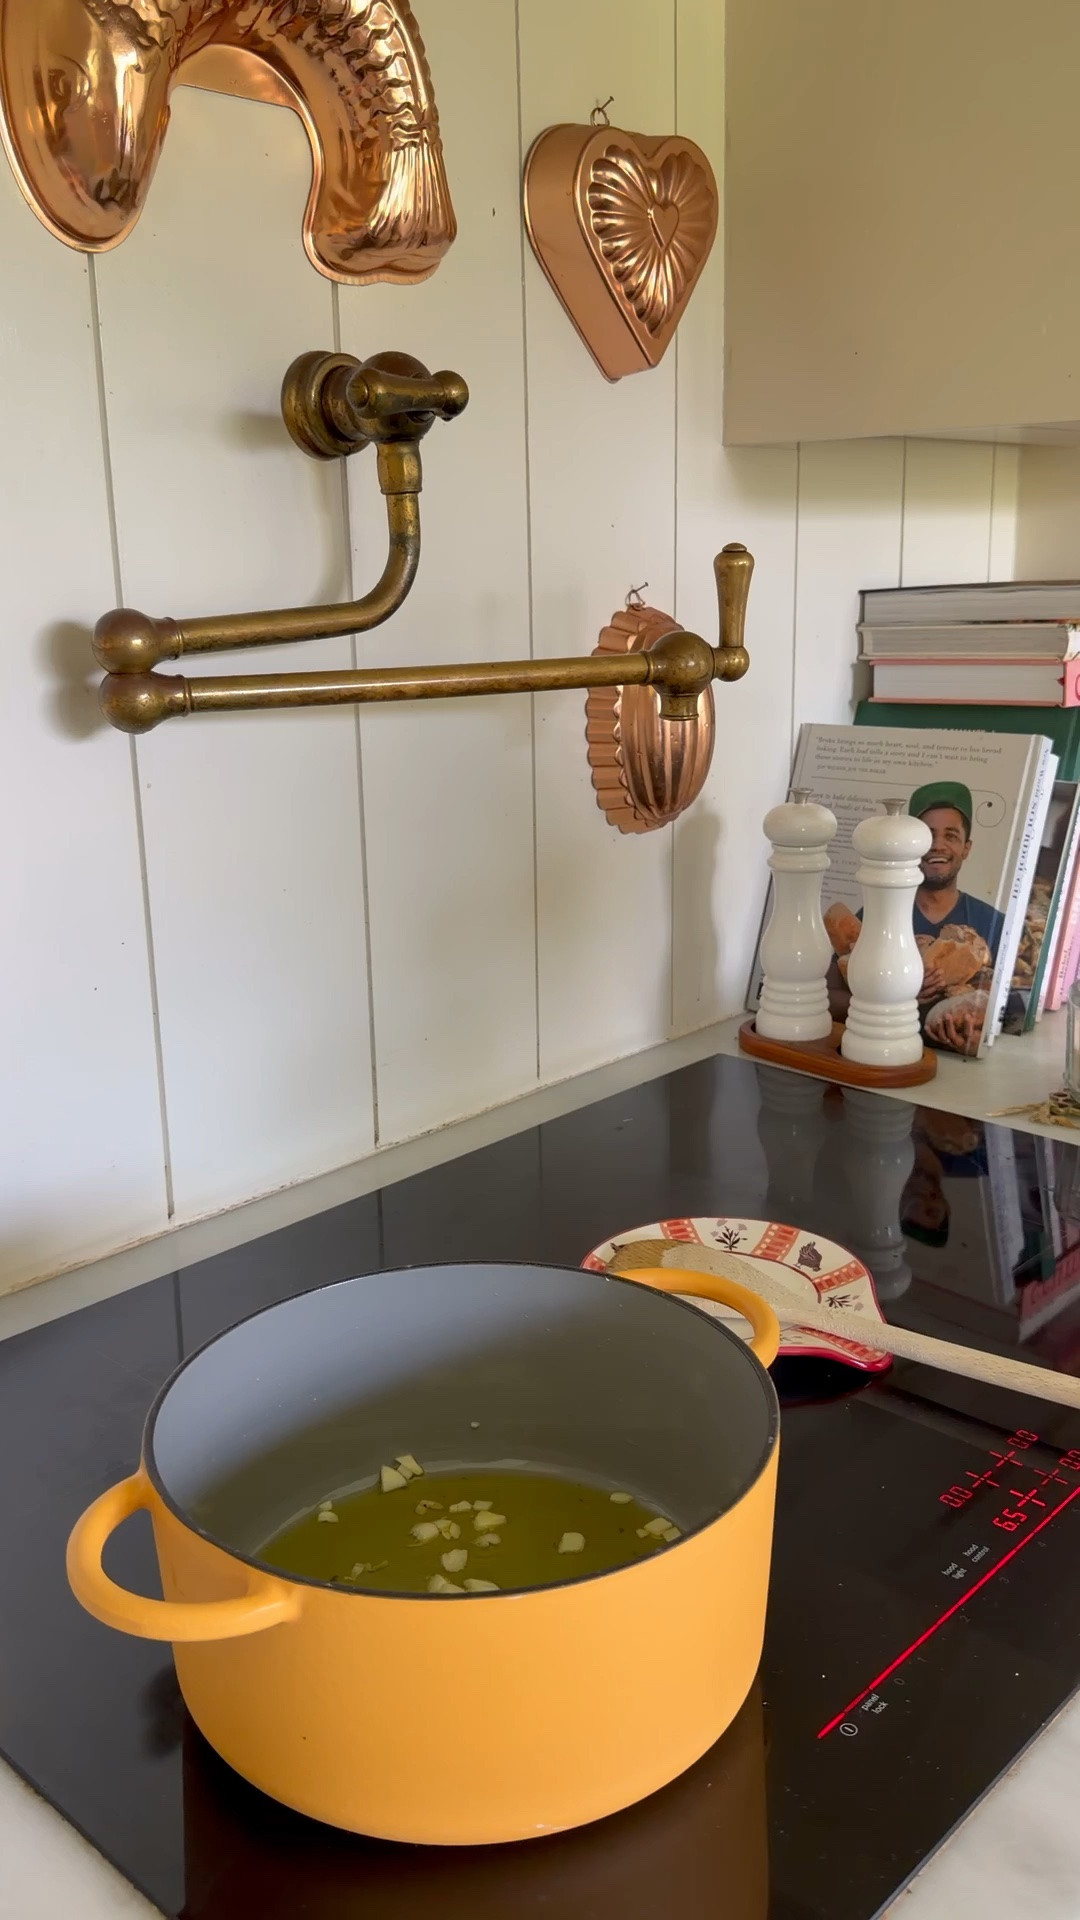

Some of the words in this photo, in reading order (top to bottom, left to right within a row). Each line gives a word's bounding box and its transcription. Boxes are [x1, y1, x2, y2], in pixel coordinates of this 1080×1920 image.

[971, 1545, 990, 1563] control
[861, 1692, 880, 1712] panel
[871, 1700, 889, 1715] lock
